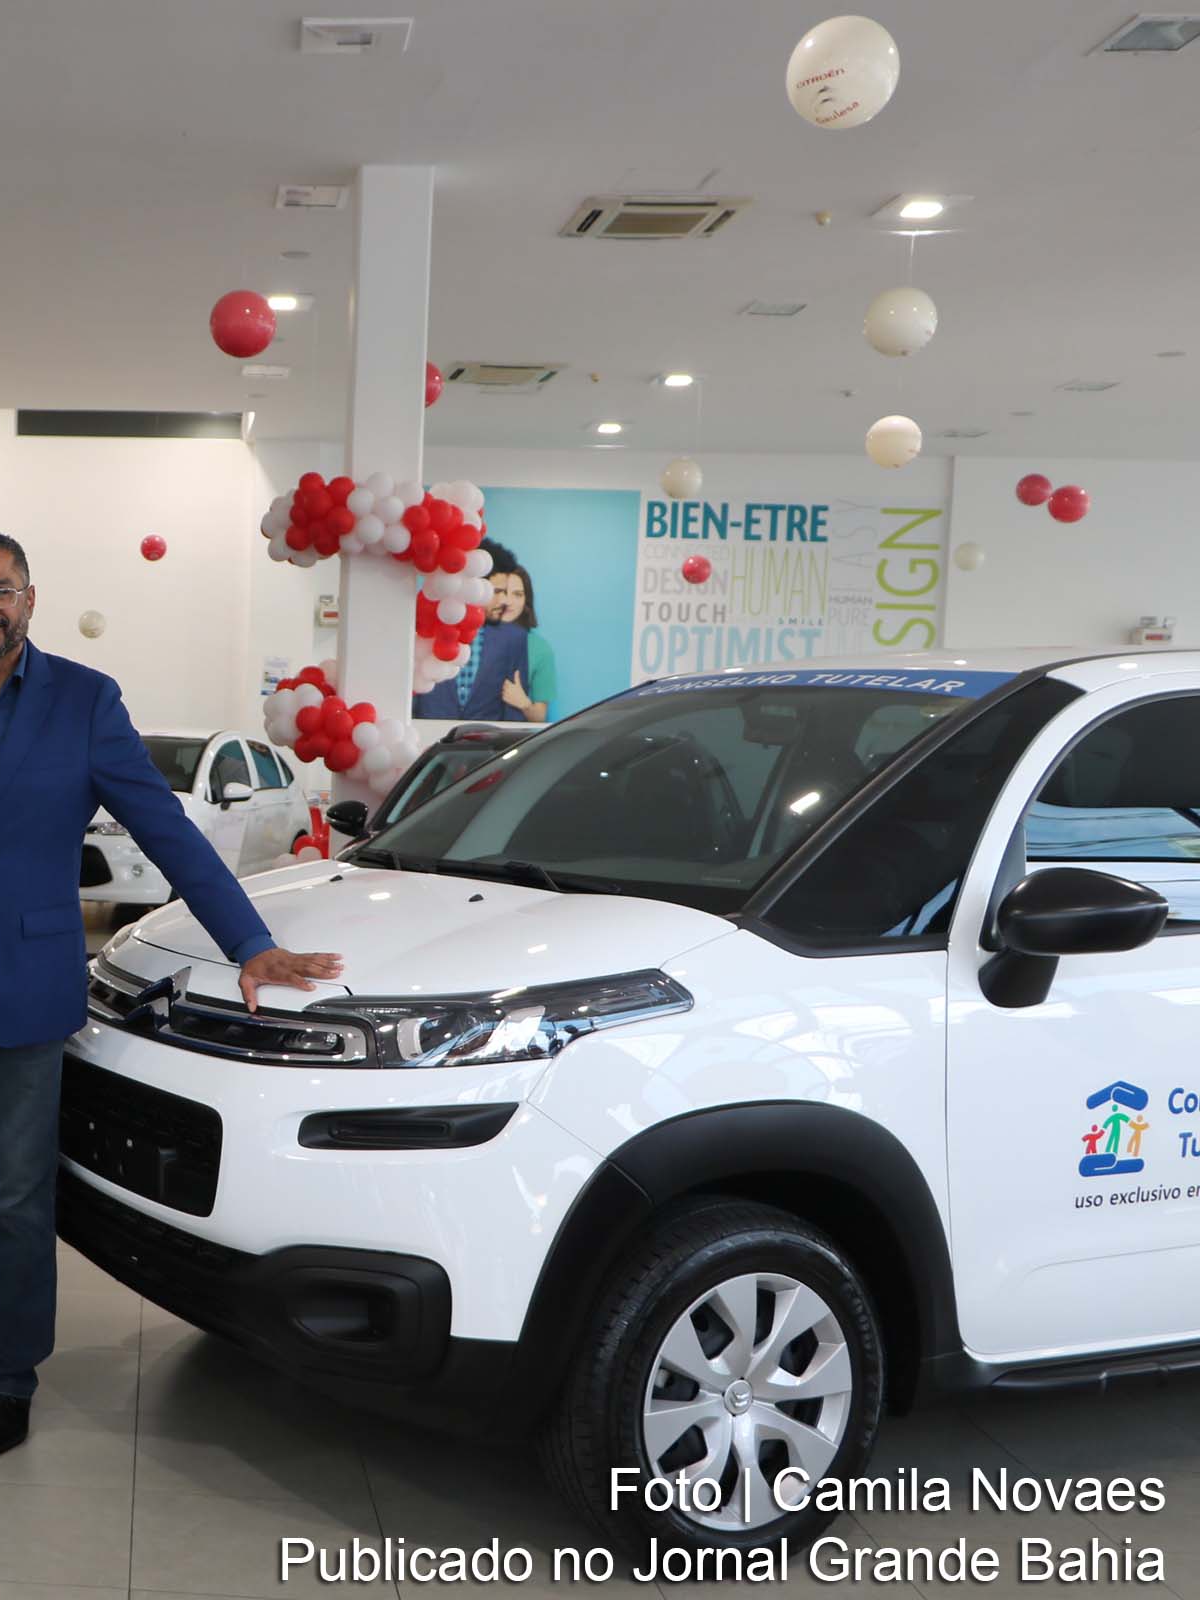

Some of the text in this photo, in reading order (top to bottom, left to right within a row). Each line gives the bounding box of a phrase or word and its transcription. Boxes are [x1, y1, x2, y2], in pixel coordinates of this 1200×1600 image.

[645, 501, 829, 542] BIEN-ETRE
[729, 544, 829, 617] HUMAN
[641, 601, 726, 624] TOUCH
[639, 624, 822, 674] OPTIMIST
[807, 673, 966, 693] TUTELAR
[1167, 1087, 1200, 1115] Co
[1075, 1194, 1103, 1209] uso
[1109, 1184, 1181, 1206] exclusivo
